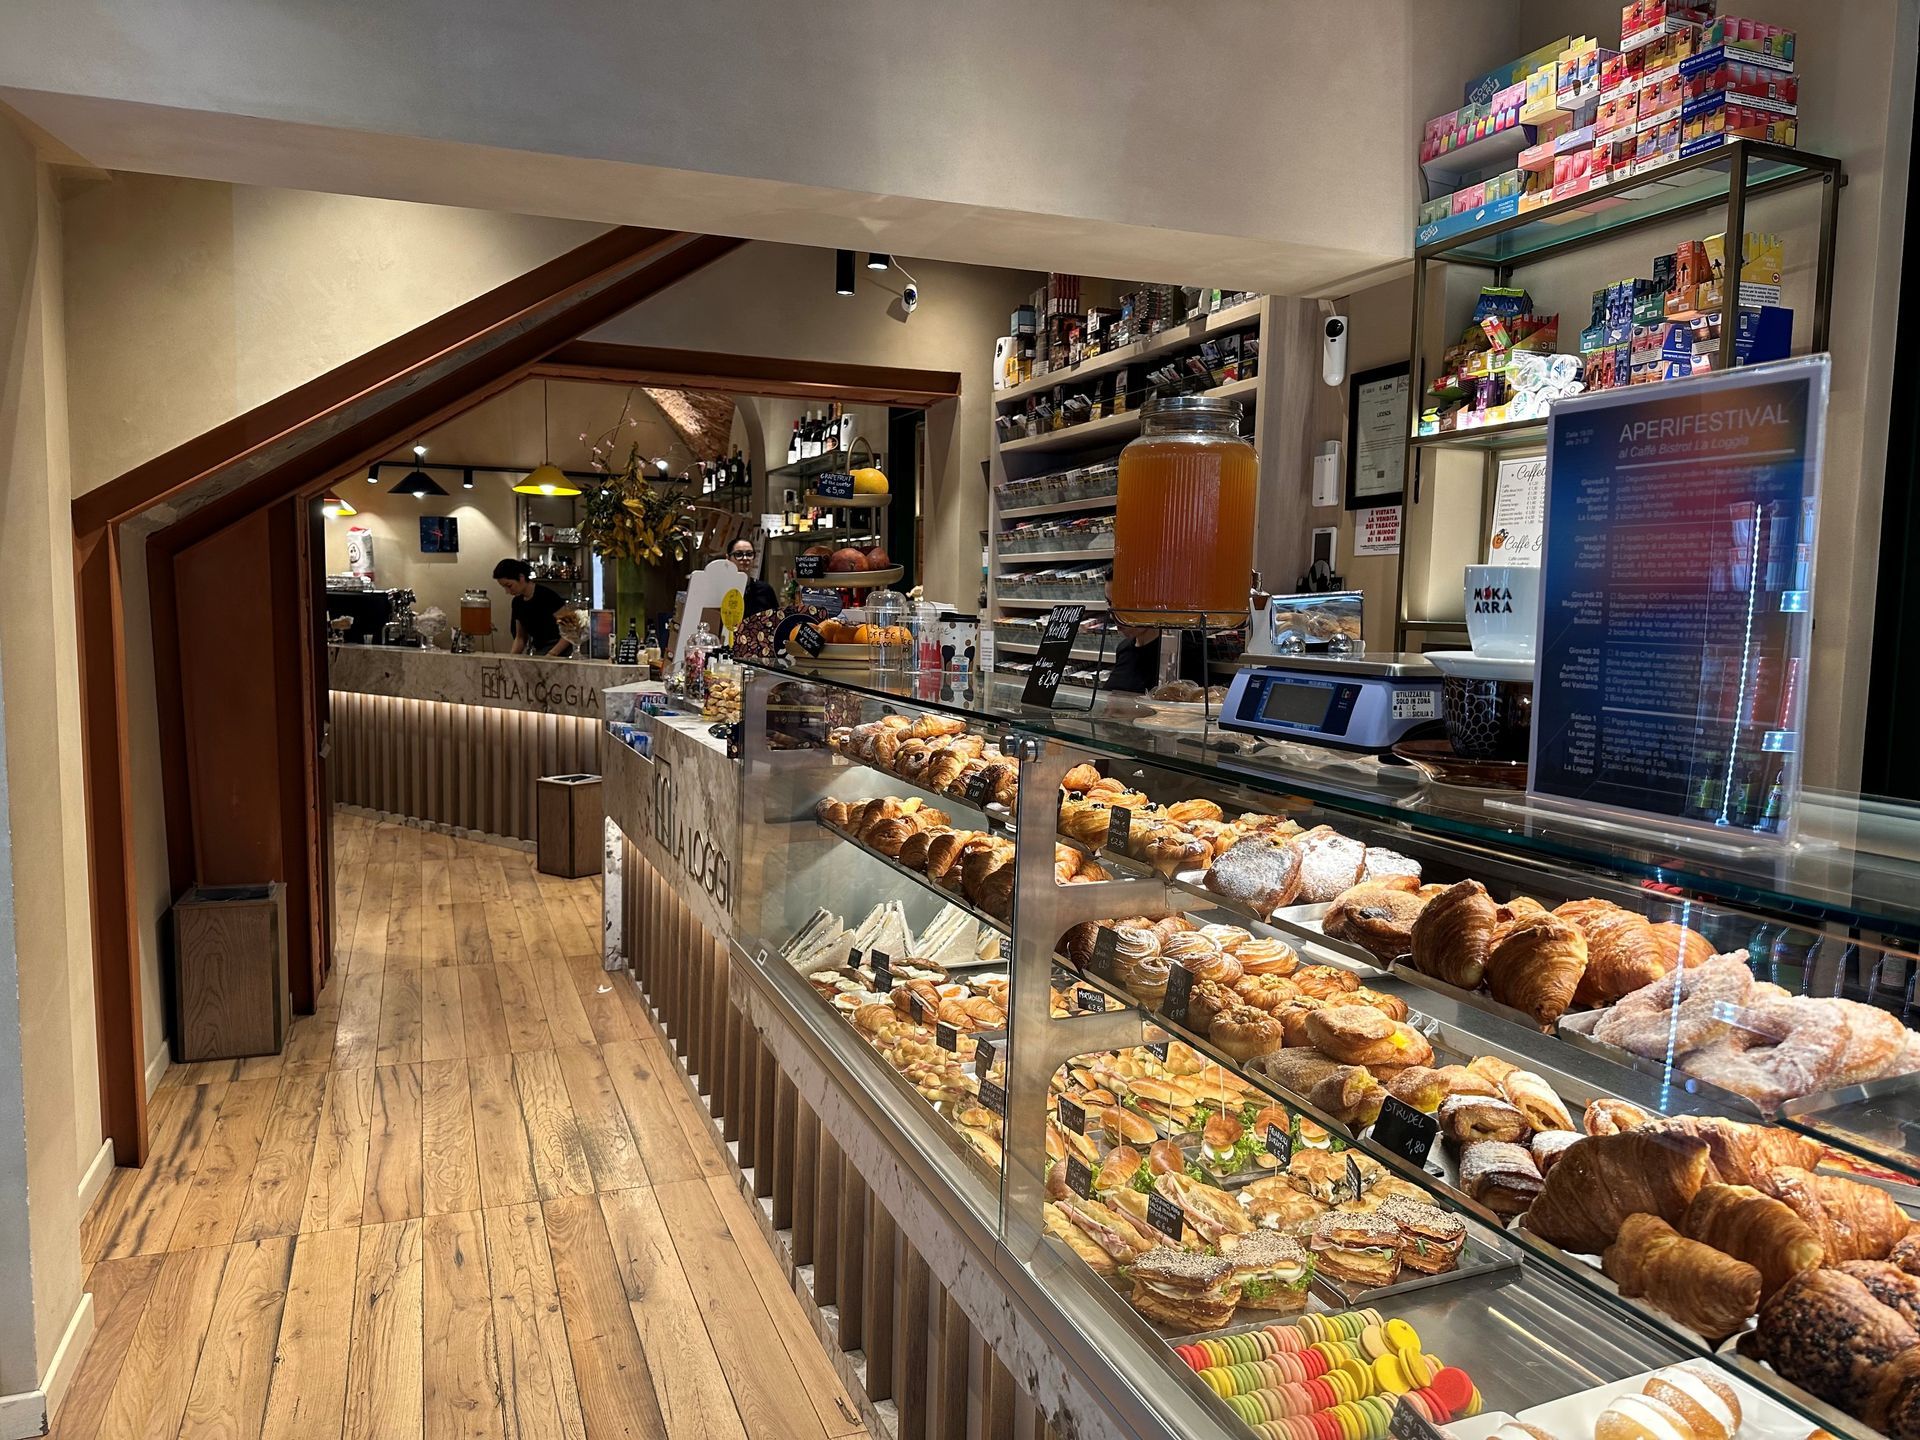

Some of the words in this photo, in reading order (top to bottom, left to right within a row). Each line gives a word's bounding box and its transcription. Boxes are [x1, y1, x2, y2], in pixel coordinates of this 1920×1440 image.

[1473, 76, 1491, 101] LOST
[1619, 403, 1790, 443] APERIFESTIVAL
[1659, 439, 1692, 456] Bistrot
[1711, 434, 1750, 452] Loggia
[820, 472, 852, 482] GRAPEFRUIT
[1475, 601, 1512, 614] ARRA
[504, 680, 521, 700] LA
[527, 682, 599, 709] LOGGIA
[1385, 1100, 1424, 1128] STRUDEL
[1406, 1138, 1425, 1154] 1,80
